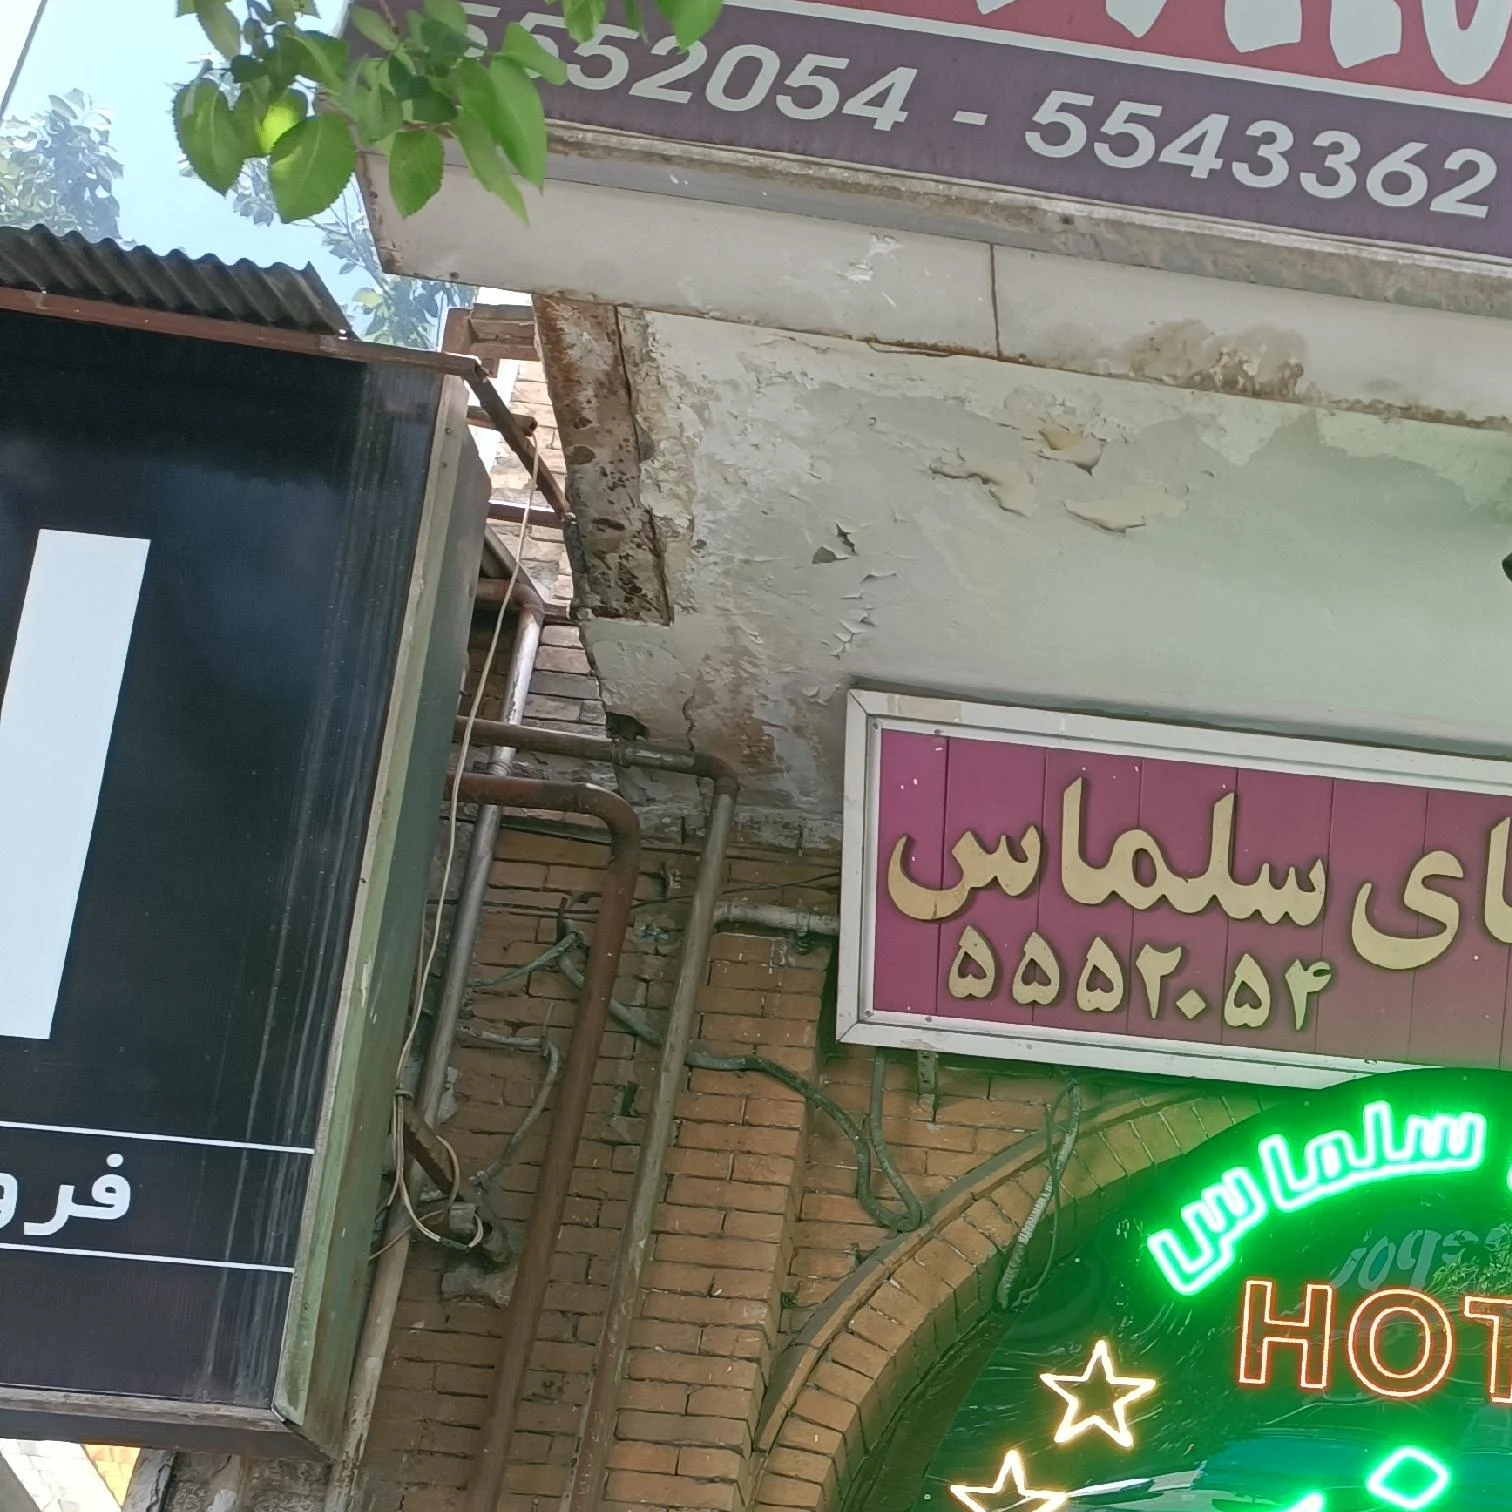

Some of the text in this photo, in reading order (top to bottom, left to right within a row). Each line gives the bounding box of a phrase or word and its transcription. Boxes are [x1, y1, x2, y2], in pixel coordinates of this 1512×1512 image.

[1024, 89, 1498, 219] 5543362
[887, 776, 1327, 927] سلماس
[947, 925, 1335, 1032] ۵۵۵۲۰۵۴
[1147, 1100, 1487, 1296] سلماس
